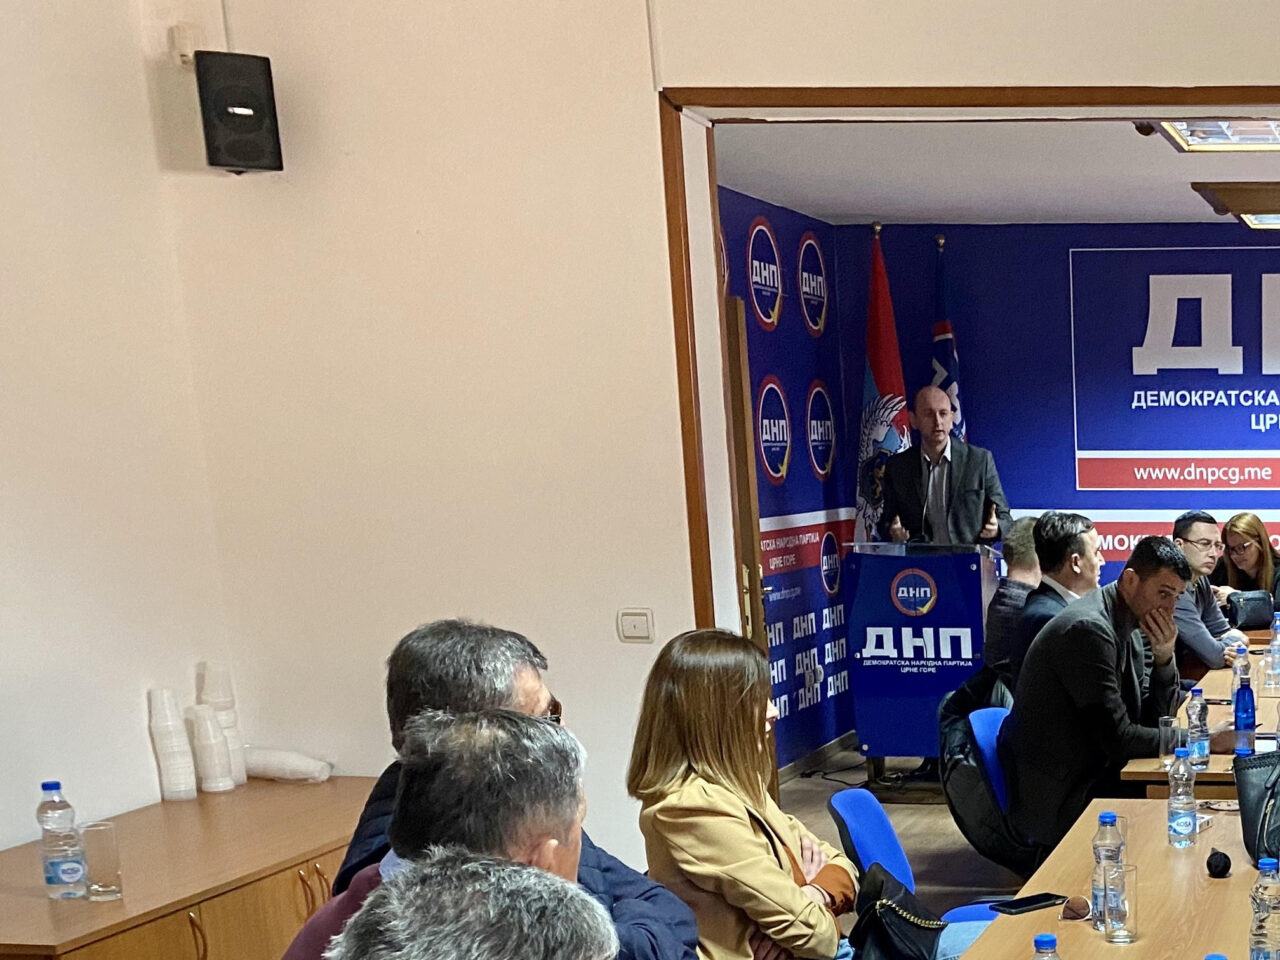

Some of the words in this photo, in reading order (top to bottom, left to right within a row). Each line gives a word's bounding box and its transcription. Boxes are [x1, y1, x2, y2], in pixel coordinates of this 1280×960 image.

[752, 260, 778, 288] ДНП
[802, 271, 825, 297] ДНП
[1131, 390, 1280, 409] ДЕМОКРАТСКА
[762, 419, 787, 441] ДНП
[810, 420, 832, 440] ДНП
[1134, 462, 1272, 485] www.dnpcg.me
[897, 586, 931, 598] ДНП
[766, 621, 784, 648] НП
[793, 612, 816, 640] ДНП
[822, 604, 845, 631] ДНП
[862, 627, 972, 659] ДНП
[769, 658, 787, 686] НП
[795, 647, 819, 677] ДНП
[824, 637, 847, 665] ДНП
[798, 682, 821, 711] ДНП
[827, 670, 849, 698] ДНП
